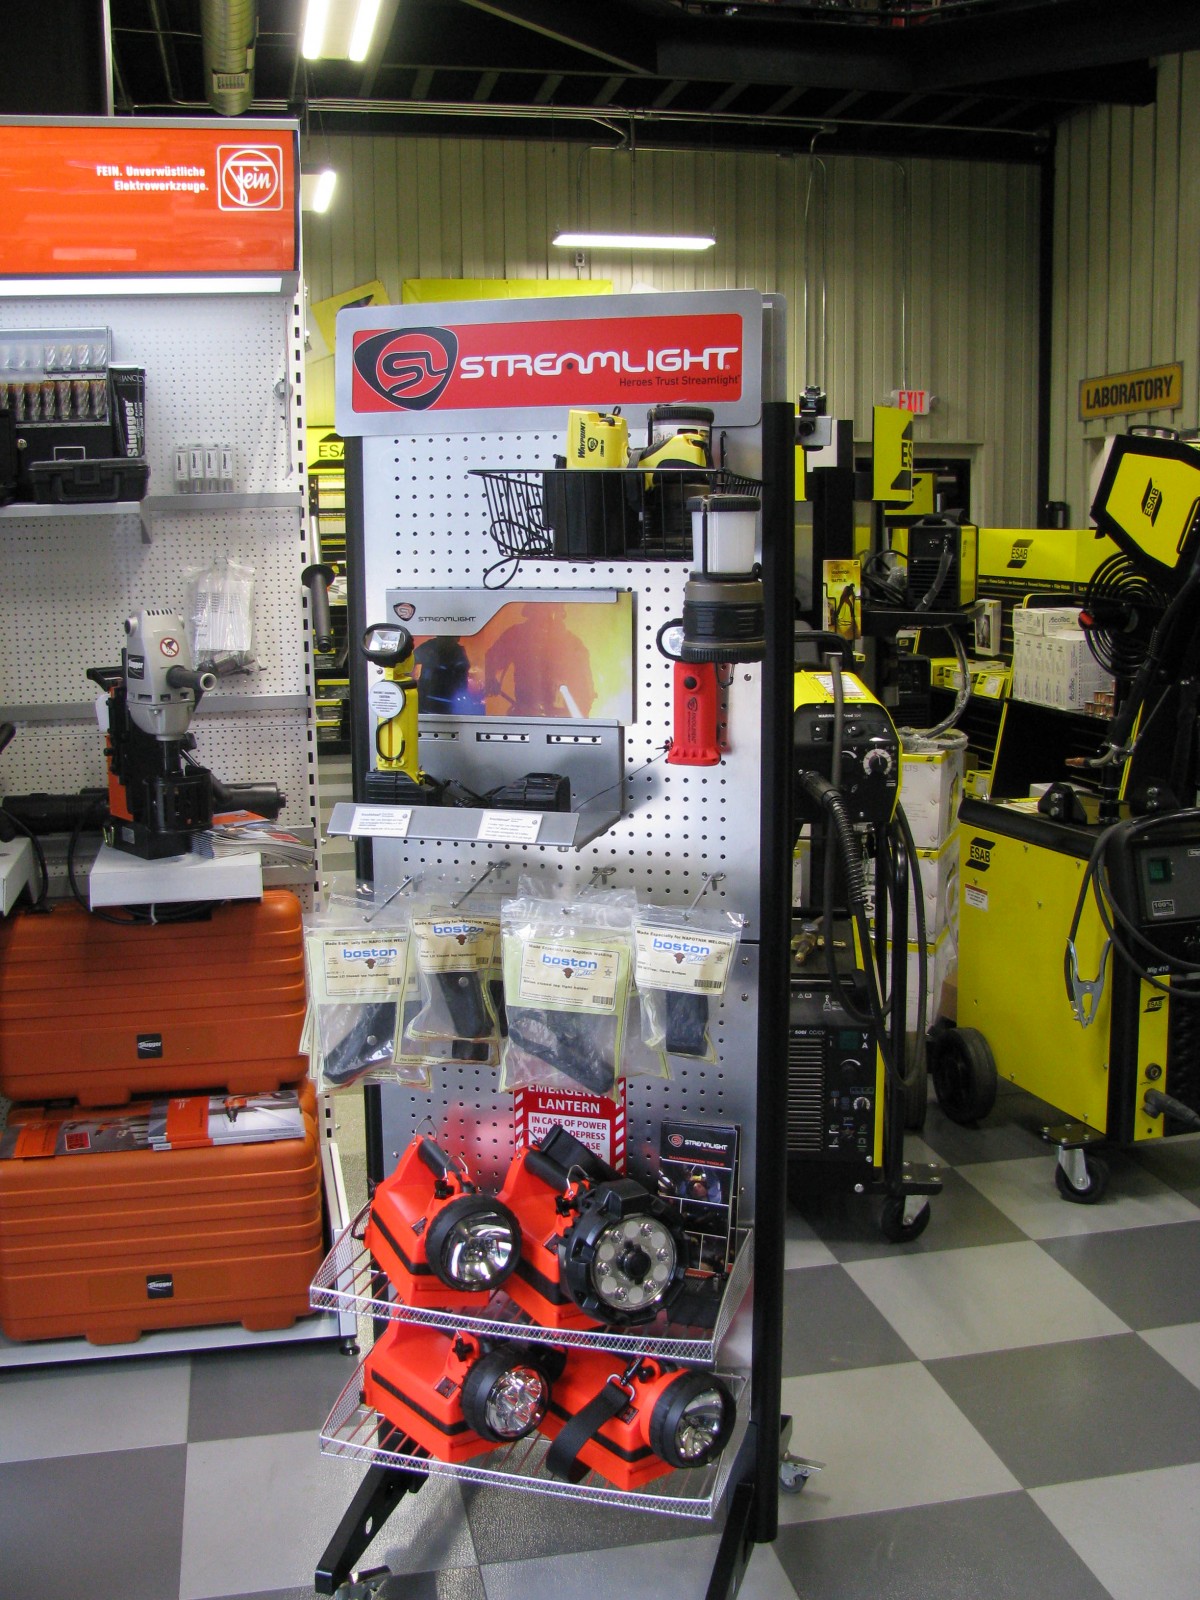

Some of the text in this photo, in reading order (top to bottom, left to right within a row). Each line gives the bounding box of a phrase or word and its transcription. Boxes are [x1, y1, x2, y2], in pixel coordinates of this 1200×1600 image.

[96, 165, 206, 177] FEIN. Unverwüstliche
[114, 180, 209, 194] Elektrowerkzeuge.
[619, 377, 653, 387] Heroes
[656, 376, 679, 387] Trust
[1086, 375, 1174, 410] LABORATORY
[898, 391, 925, 413] EXIT
[124, 401, 139, 457] Slugger
[1143, 488, 1160, 517] ESAB
[1011, 548, 1028, 559] ESAB
[970, 846, 991, 863] ESAB
[433, 924, 484, 934] boston
[343, 948, 397, 958] boston
[653, 938, 710, 955] boston
[542, 953, 598, 969] boston
[538, 1098, 600, 1114] LANTERN
[531, 1115, 540, 1124] IN
[541, 1117, 562, 1126] CASE
[577, 1121, 607, 1130] POWER
[569, 1130, 606, 1141] DEPRESS
[684, 1139, 728, 1150] STREAMLIGHT
